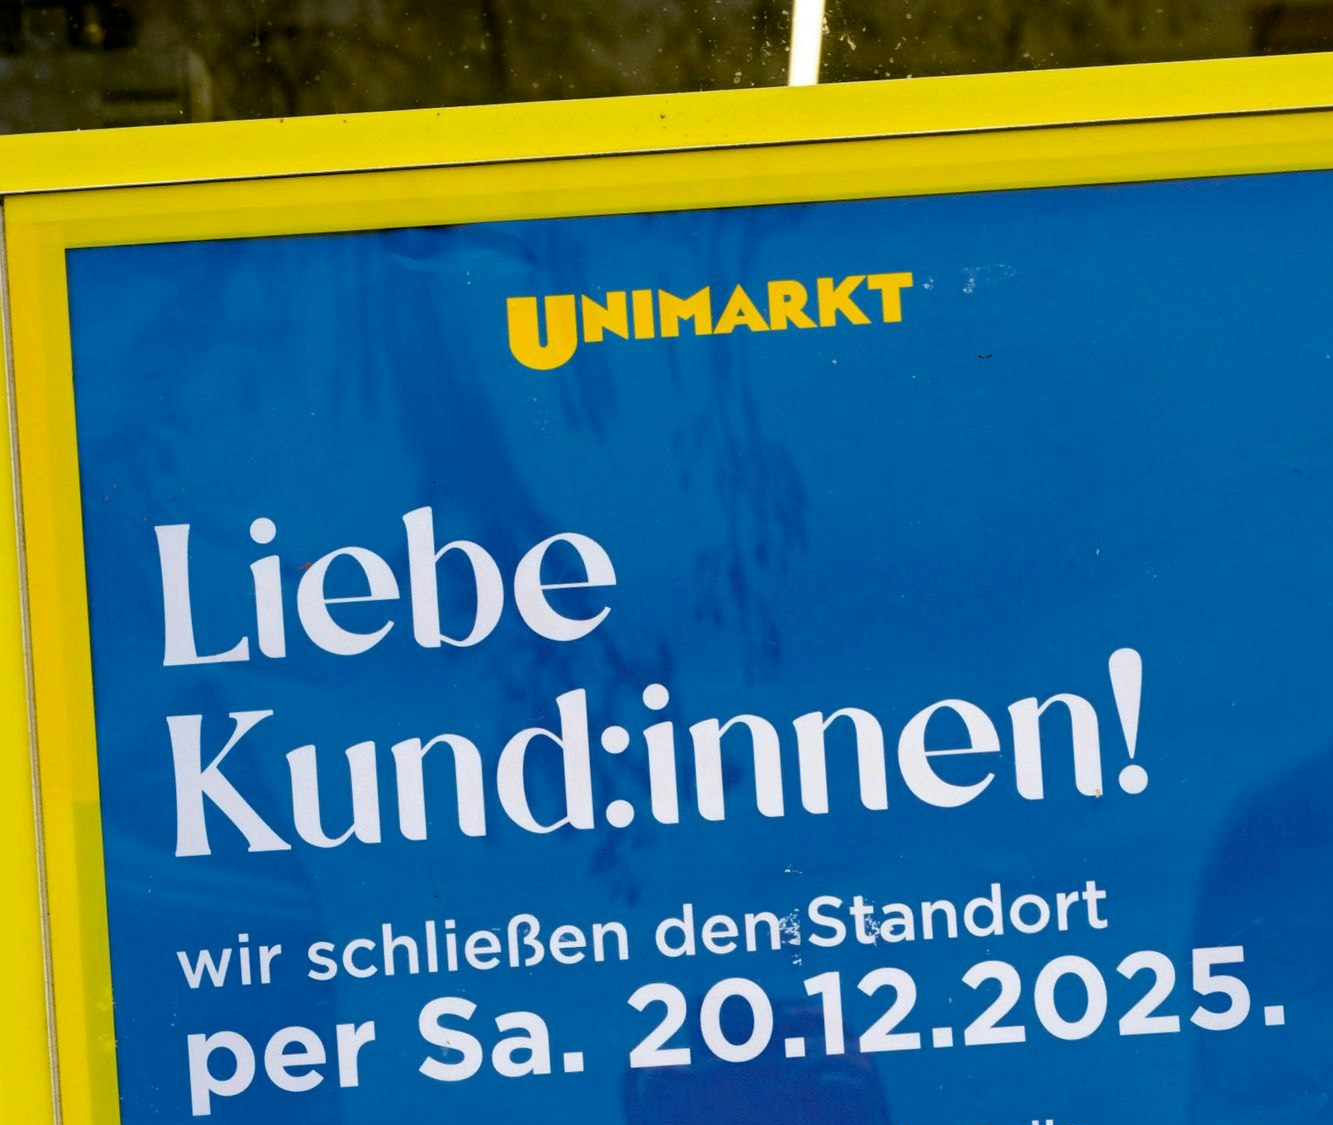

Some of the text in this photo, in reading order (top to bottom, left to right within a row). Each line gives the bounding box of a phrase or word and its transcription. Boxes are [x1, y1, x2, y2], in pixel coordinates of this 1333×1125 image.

[506, 272, 913, 371] UNIMARKT
[155, 507, 616, 666] Liebe
[167, 648, 1148, 856] Kund:innen!
[177, 881, 1107, 988] wir schließen den Standort
[188, 946, 1284, 1115] per Sa. 20.12.2025.
